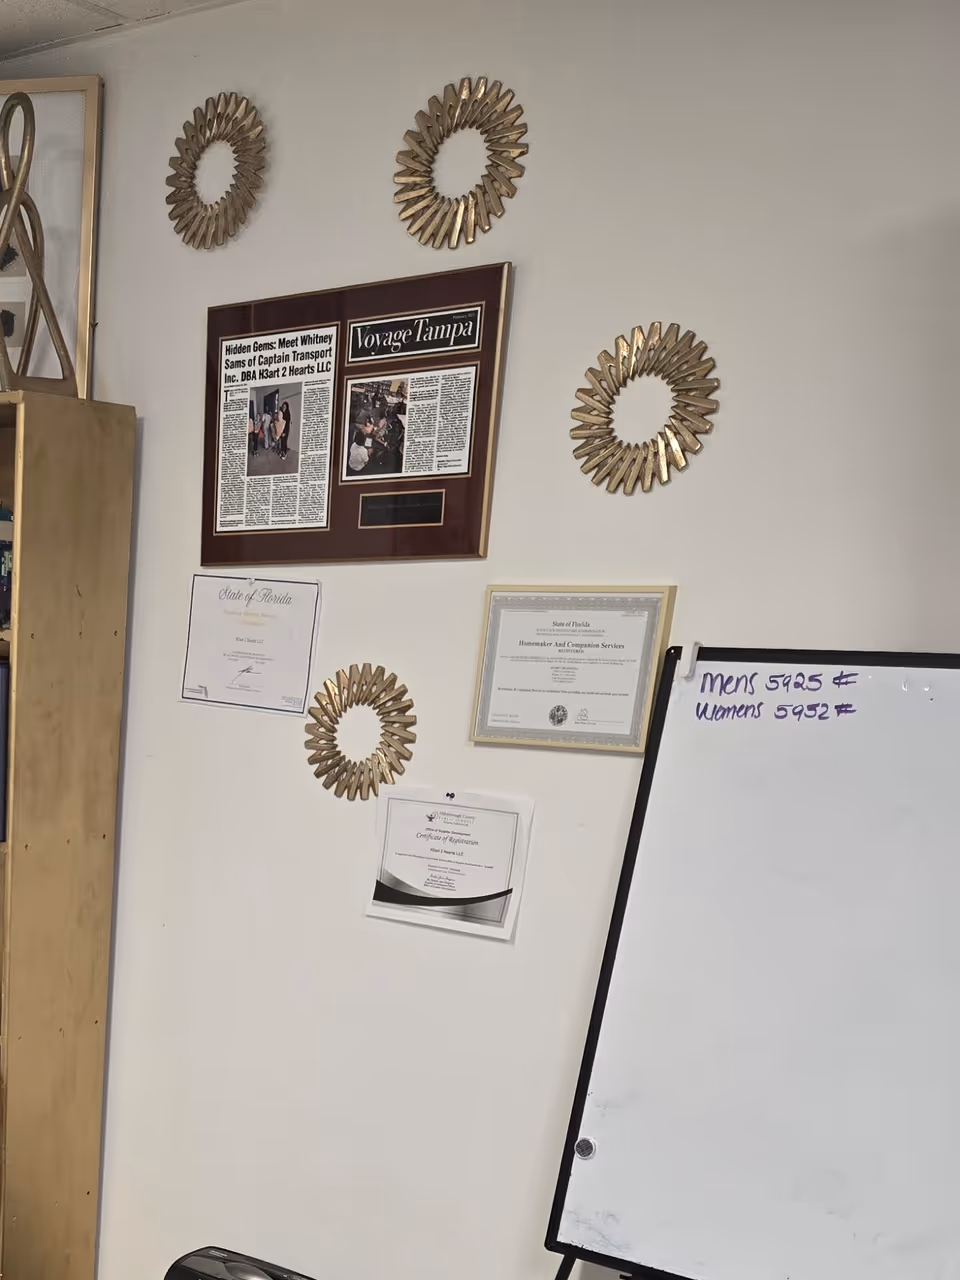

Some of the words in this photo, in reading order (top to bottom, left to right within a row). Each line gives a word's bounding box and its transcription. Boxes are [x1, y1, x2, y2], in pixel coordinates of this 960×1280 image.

[225, 343, 252, 356] Hidden
[253, 341, 277, 352] Gems:
[278, 337, 299, 350] Meet
[300, 333, 333, 346] Whitney
[356, 325, 413, 356] Voyage
[414, 318, 473, 346] Tampa
[225, 358, 246, 370] Sams
[247, 355, 257, 367] of
[258, 351, 290, 367] Captain
[292, 346, 332, 362] Transport
[224, 373, 239, 384] Inc.
[240, 369, 257, 382] DBA
[258, 367, 280, 380] H3art
[281, 366, 287, 377] 2
[288, 363, 315, 377] Hearts
[316, 361, 332, 374] LLC
[218, 586, 244, 600] State
[245, 589, 258, 607] of
[258, 588, 293, 606] Florida
[552, 620, 564, 628] State
[553, 640, 566, 648] And
[566, 641, 600, 650] Companion
[700, 672, 759, 696] Mens
[765, 672, 823, 693] 5925
[696, 701, 764, 721] Womens
[774, 702, 830, 722] 5952
[416, 831, 442, 841] Certificate
[442, 834, 449, 844] of
[449, 836, 479, 846] Registration
